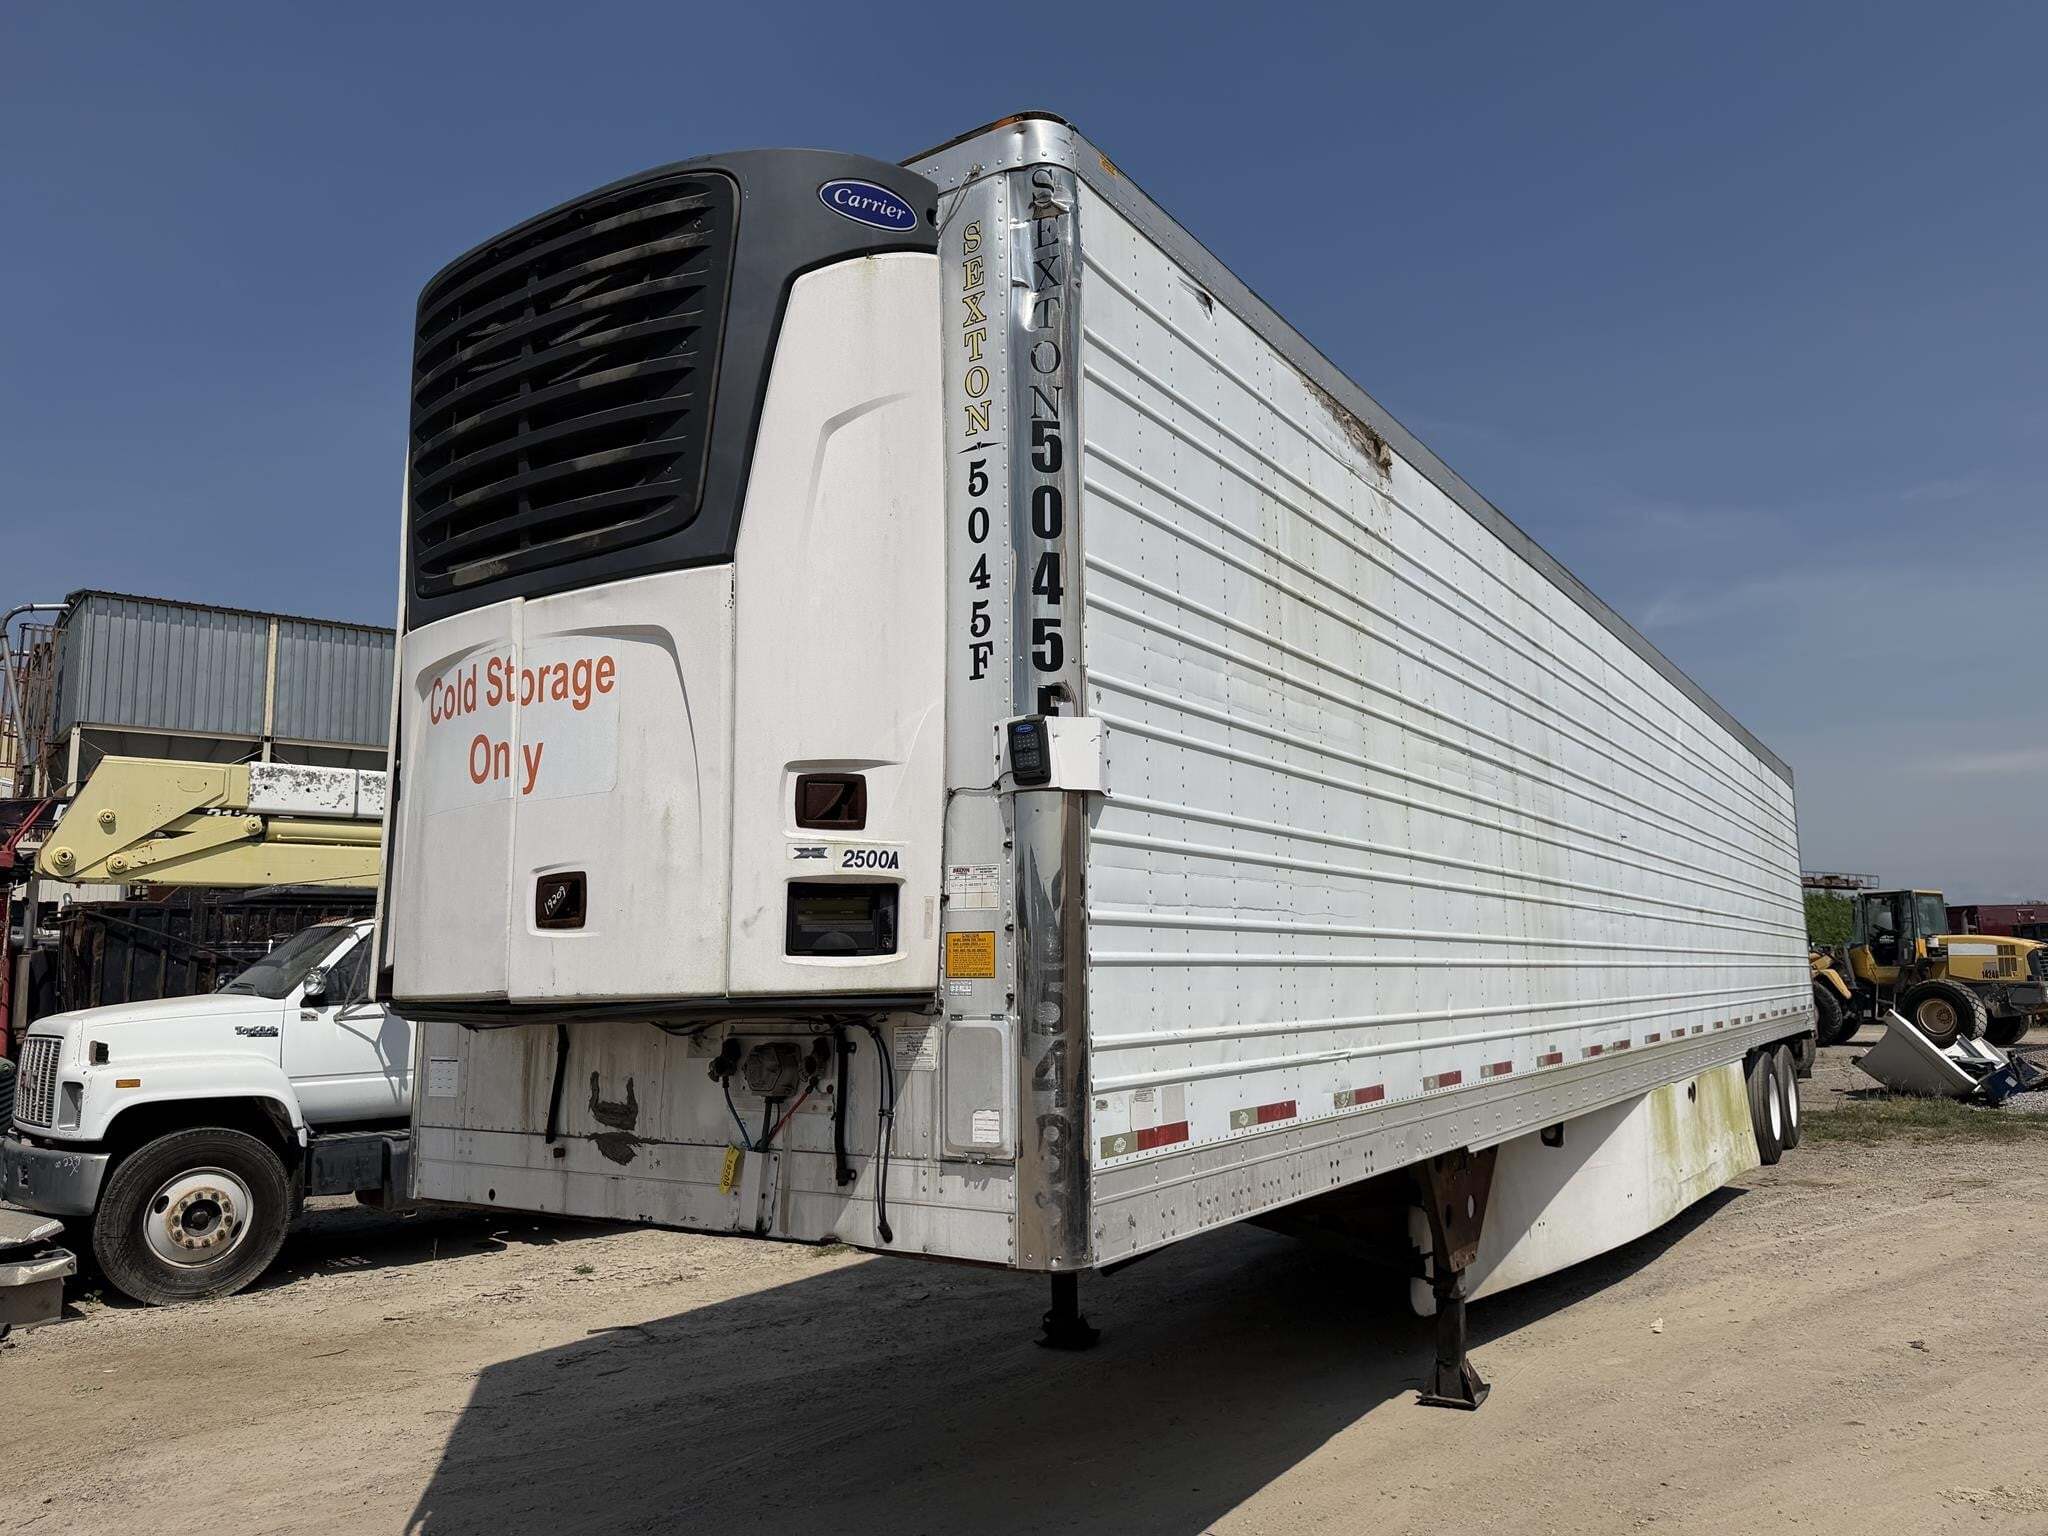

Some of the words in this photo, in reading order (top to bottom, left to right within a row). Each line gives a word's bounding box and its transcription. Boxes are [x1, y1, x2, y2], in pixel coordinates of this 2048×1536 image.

[834, 188, 905, 220] Carrier
[963, 220, 991, 436] SEXTON
[1029, 169, 1063, 420] SEXTON
[968, 458, 993, 680] 5045F
[430, 664, 477, 725] Cold
[486, 655, 616, 711] Storage
[470, 734, 544, 795] Ony
[841, 850, 899, 869] 2500A
